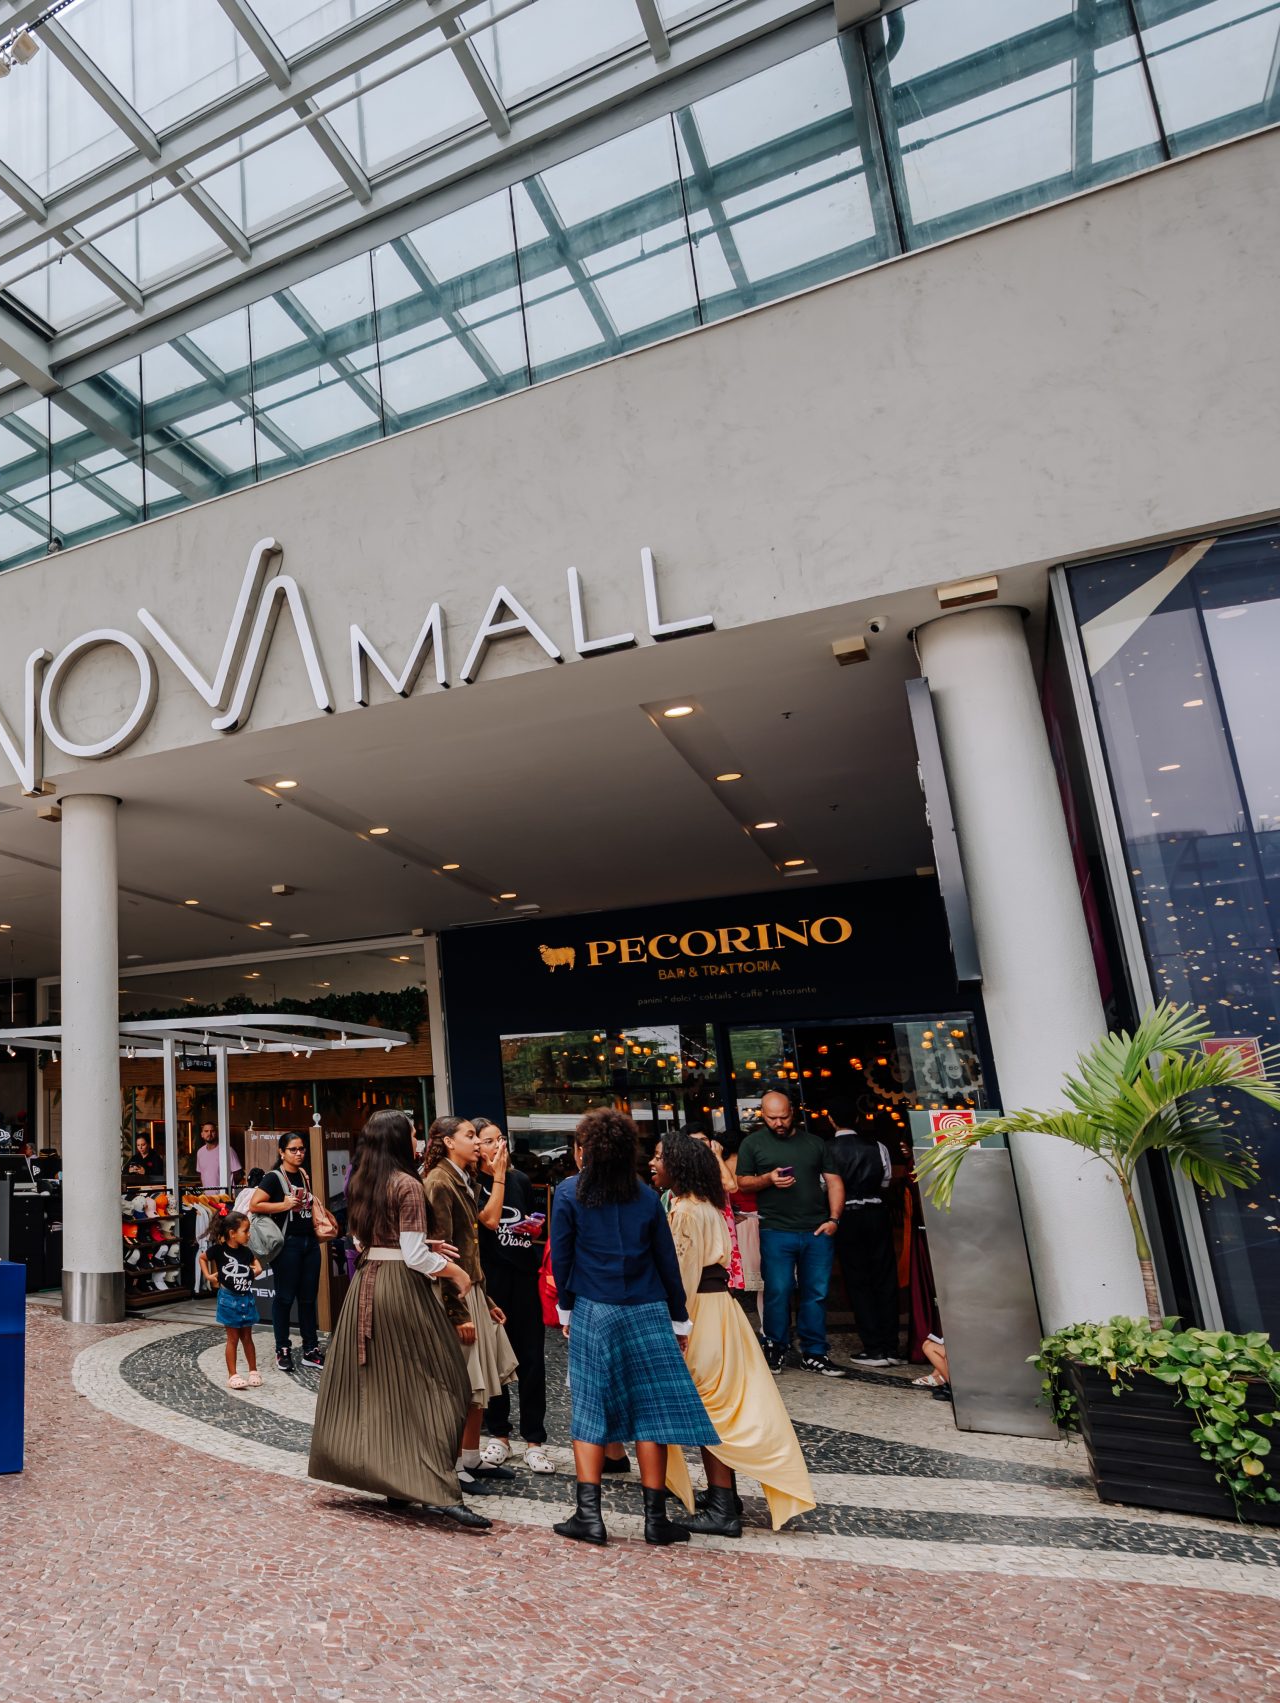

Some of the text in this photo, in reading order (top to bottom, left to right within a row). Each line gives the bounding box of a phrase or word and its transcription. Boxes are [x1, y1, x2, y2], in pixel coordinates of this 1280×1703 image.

[350, 547, 715, 706] MALL
[585, 917, 853, 967] PECORINO
[658, 960, 781, 980] BAR & TRATTORIA
[638, 995, 662, 1007] panini
[670, 993, 691, 1003] dolci
[699, 991, 732, 1001] coktails
[772, 986, 817, 997] ristorante
[498, 1233, 532, 1248] Visão
